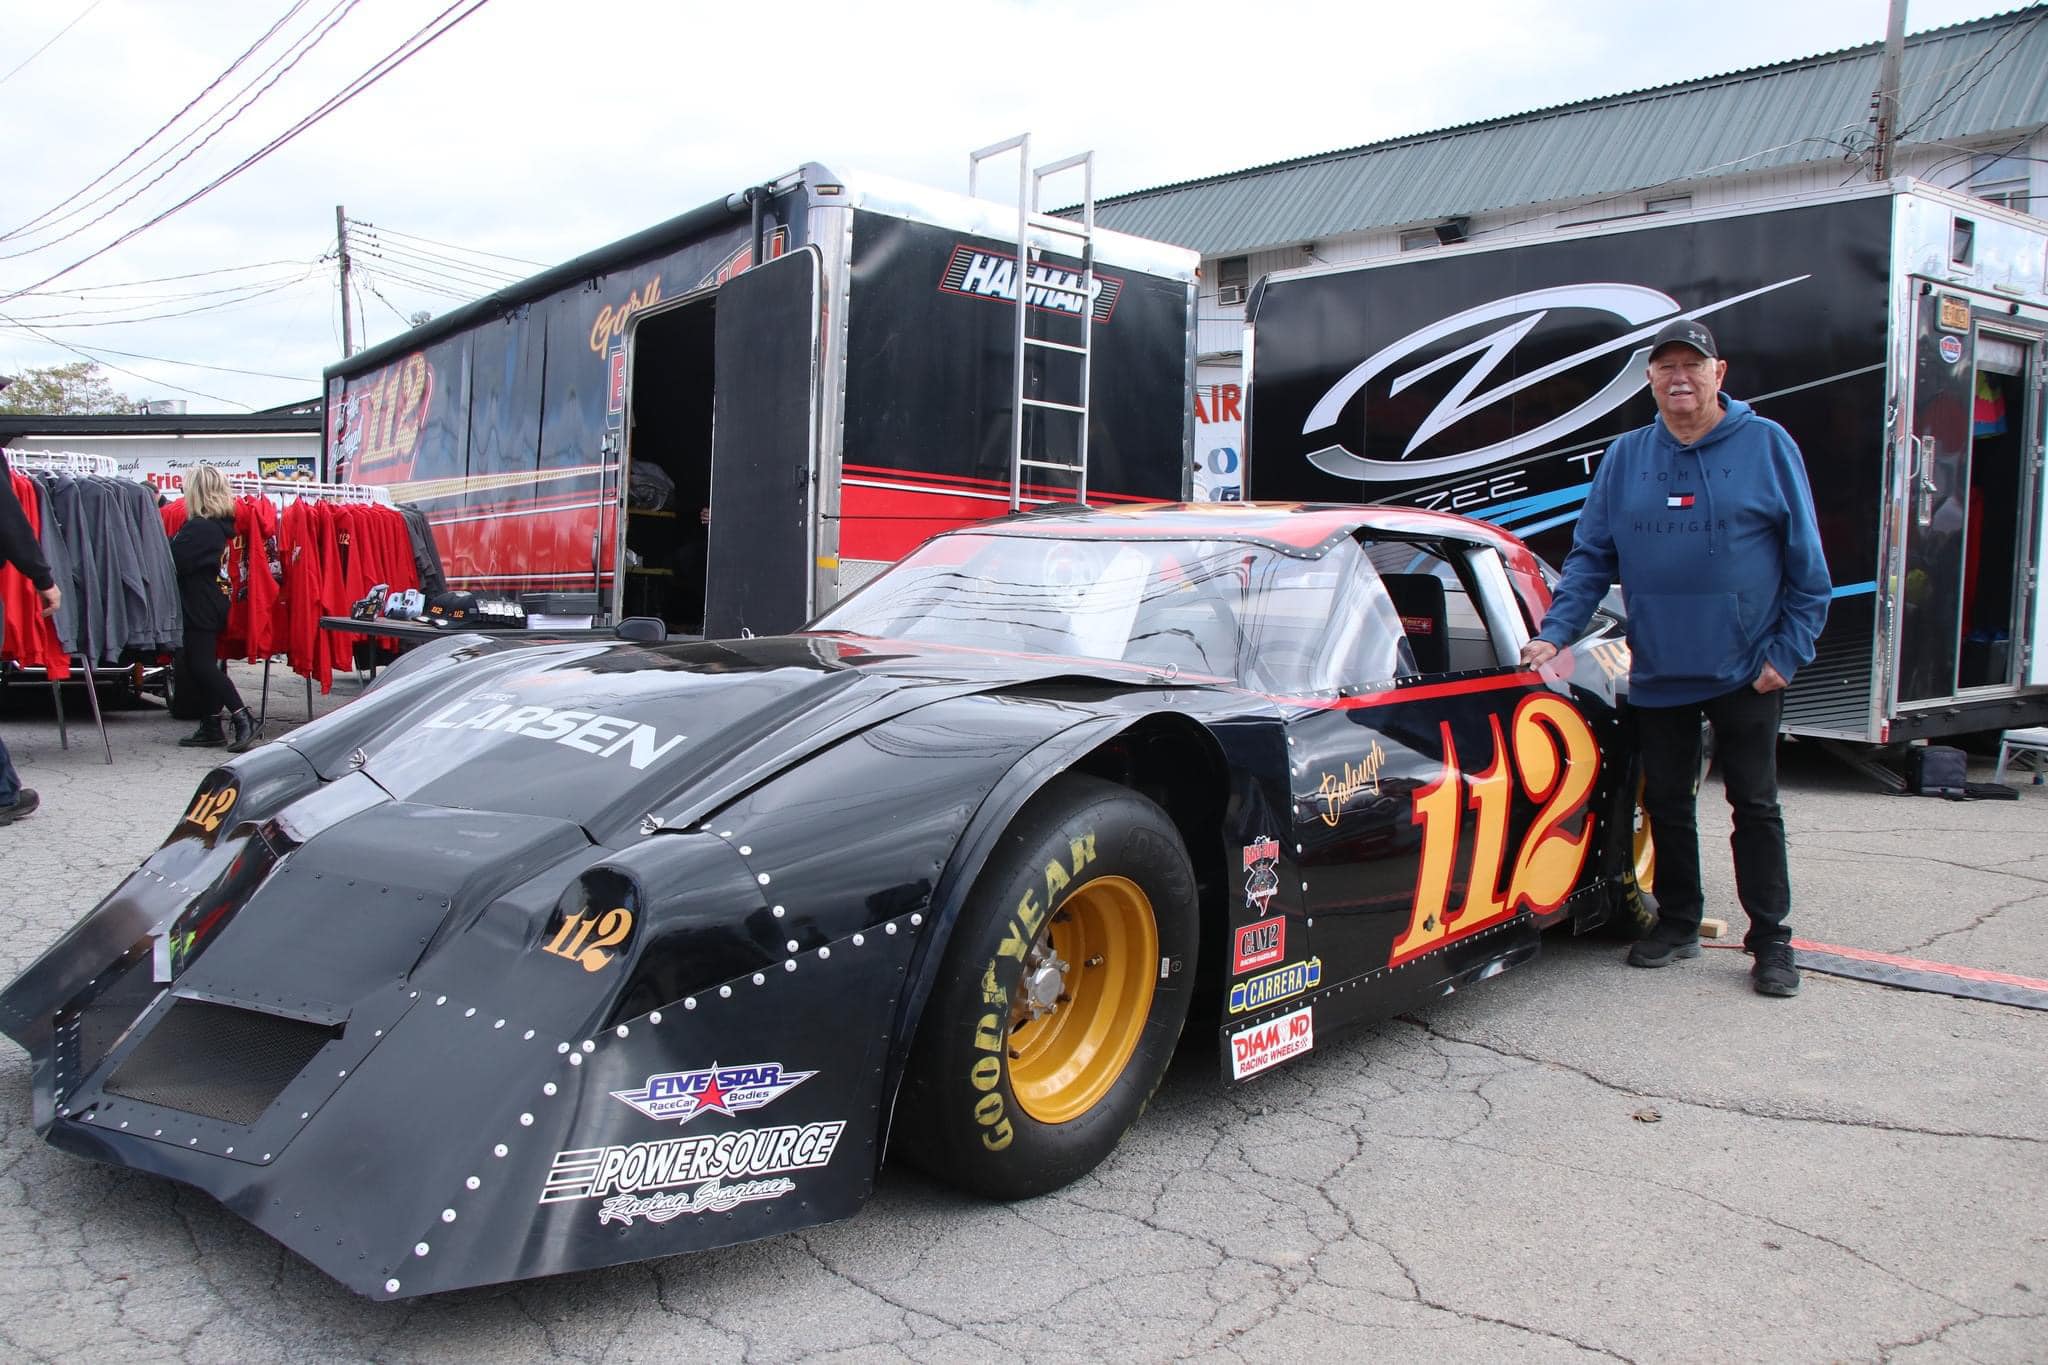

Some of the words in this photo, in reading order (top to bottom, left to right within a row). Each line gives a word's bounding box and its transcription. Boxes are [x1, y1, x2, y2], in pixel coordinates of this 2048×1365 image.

[361, 352, 426, 465] 112
[146, 473, 184, 490] Frie
[1640, 468, 1732, 482] TOMMY
[1634, 520, 1728, 534] HILFIGER
[421, 702, 689, 770] LARSEN
[1321, 738, 1385, 828] Balough
[186, 787, 237, 832] 112
[1389, 692, 1600, 968] 112
[542, 907, 633, 973] 112
[1241, 923, 1280, 957] CAM2
[1250, 967, 1302, 1005] CARRERA
[1240, 1053, 1268, 1073] RACING
[1270, 1042, 1299, 1061] WHEELS
[649, 1074, 709, 1100] FIVE
[717, 1066, 780, 1087] STAR
[649, 1099, 695, 1111] RaceCar
[729, 1090, 769, 1101] Bodies
[597, 1122, 843, 1193] POWERSOURCE
[600, 1192, 689, 1224] Racing
[694, 1178, 795, 1213] Engines
